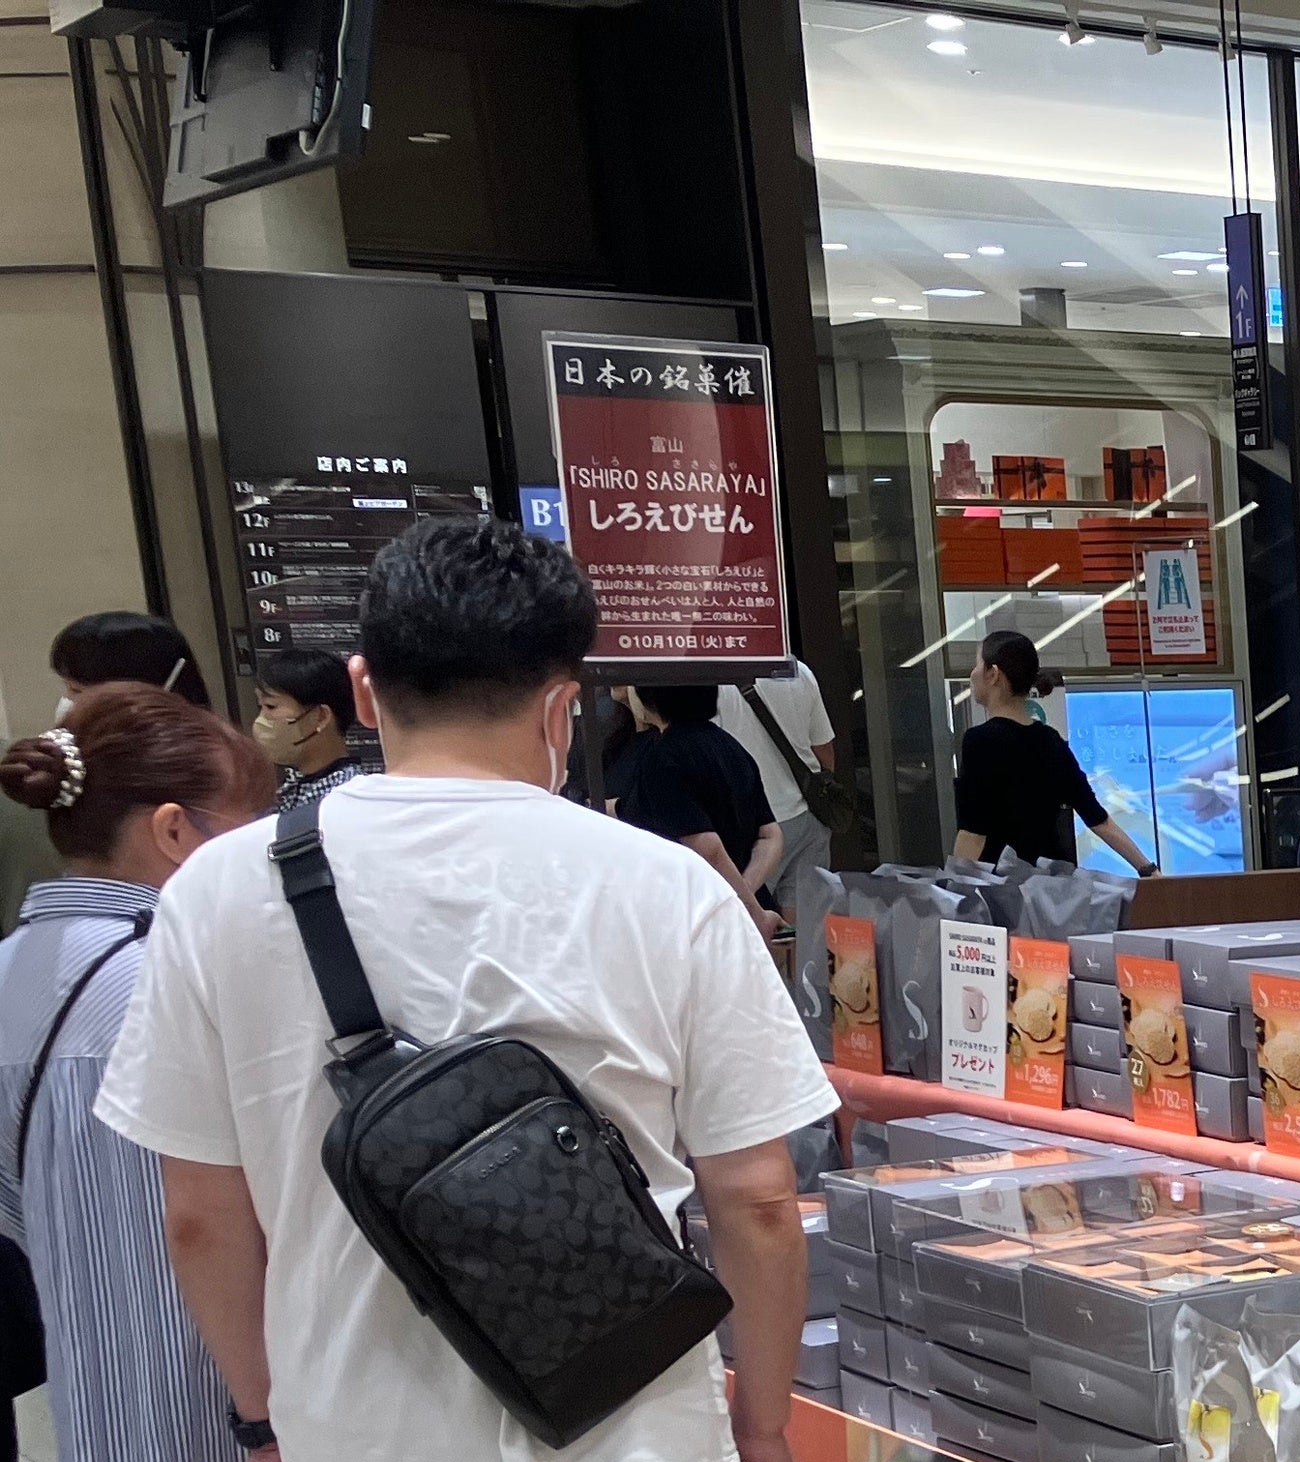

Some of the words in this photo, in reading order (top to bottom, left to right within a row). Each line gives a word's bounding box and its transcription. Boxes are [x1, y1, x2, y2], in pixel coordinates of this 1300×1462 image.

[1235, 311, 1252, 340] 1F
[563, 357, 756, 397] 日本の銘菓催
[650, 436, 684, 454] 富山
[316, 456, 408, 474] 店内ご案内
[243, 513, 270, 528] 12F
[588, 499, 755, 534] しろえびせん
[248, 543, 275, 557] 11F
[251, 570, 278, 586] 10F
[259, 599, 278, 615] 9F
[264, 627, 282, 643] 8F
[951, 1053, 996, 1075] プレゼント
